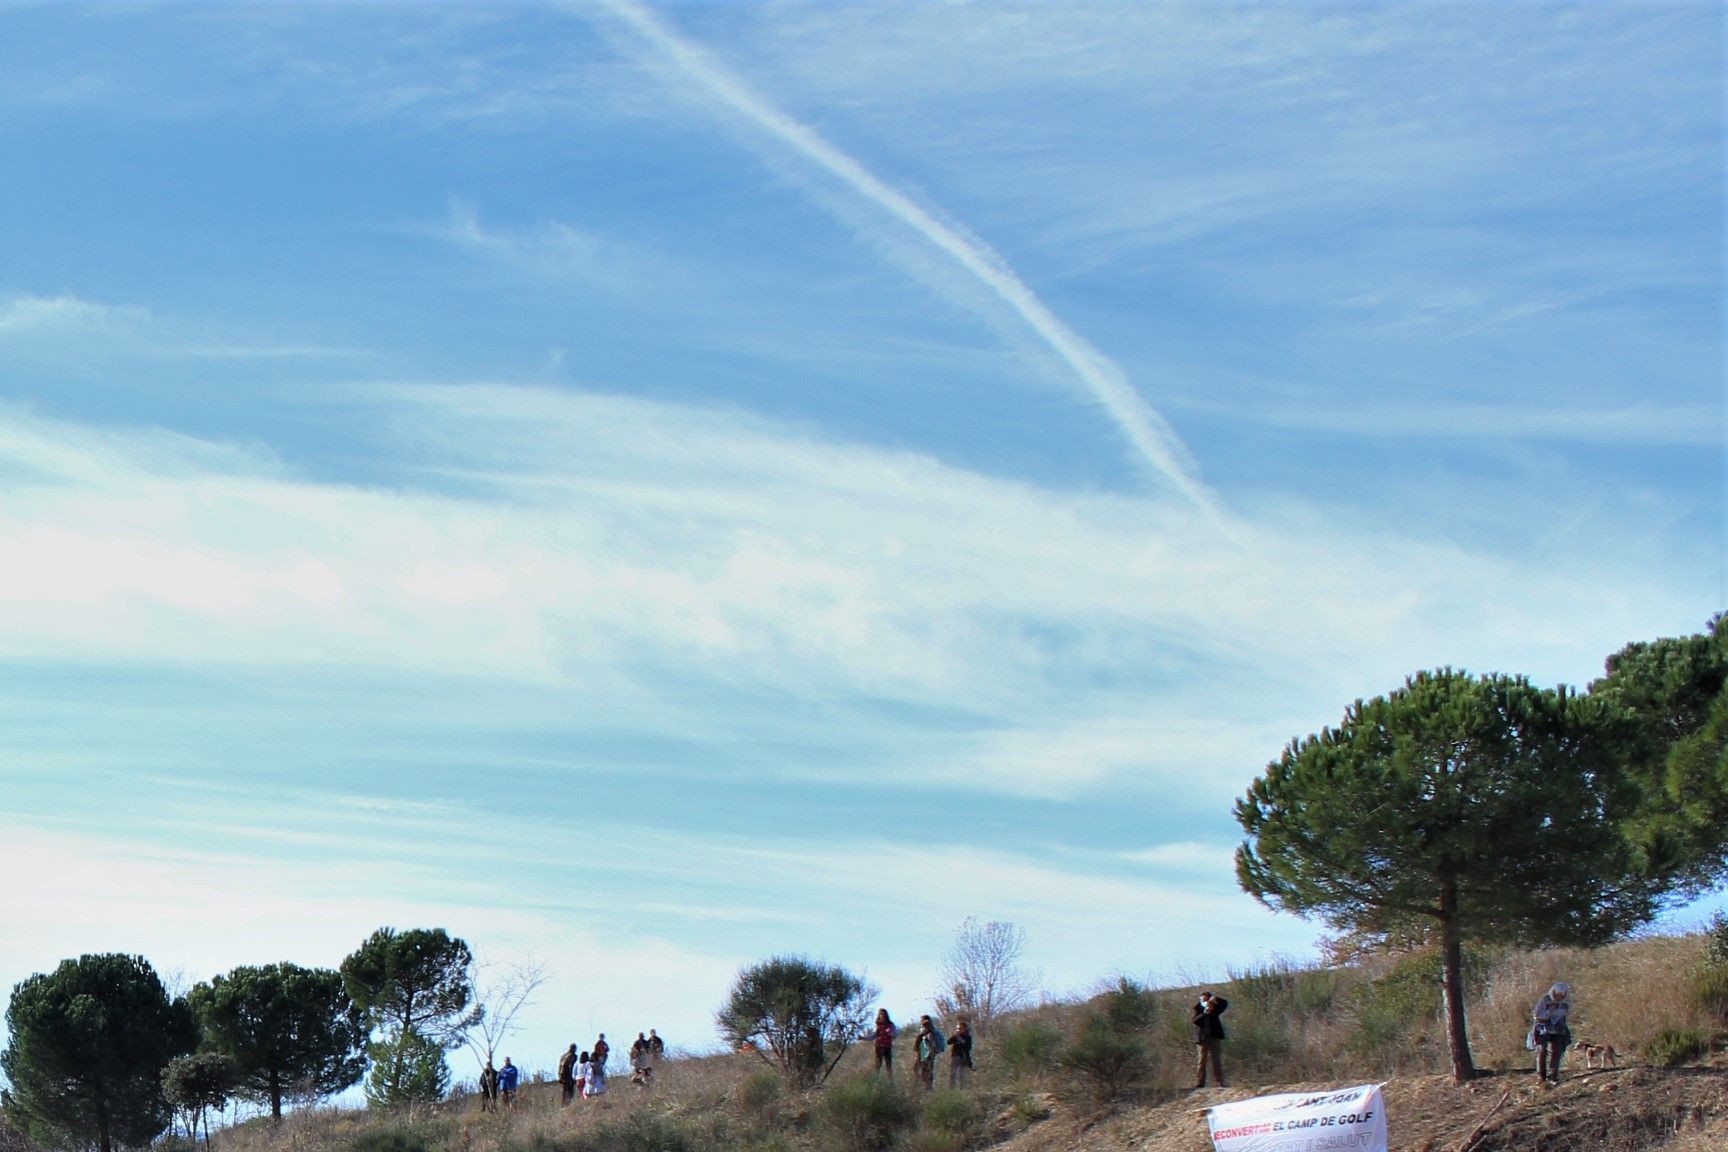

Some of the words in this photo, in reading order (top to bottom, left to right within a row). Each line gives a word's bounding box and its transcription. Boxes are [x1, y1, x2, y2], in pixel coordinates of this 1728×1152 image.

[1273, 1121, 1285, 1132] EL
[1287, 1117, 1318, 1130] CAMP
[1321, 1115, 1336, 1127] DE
[1338, 1111, 1374, 1125] GOLF
[1315, 1131, 1372, 1151] SALUT
